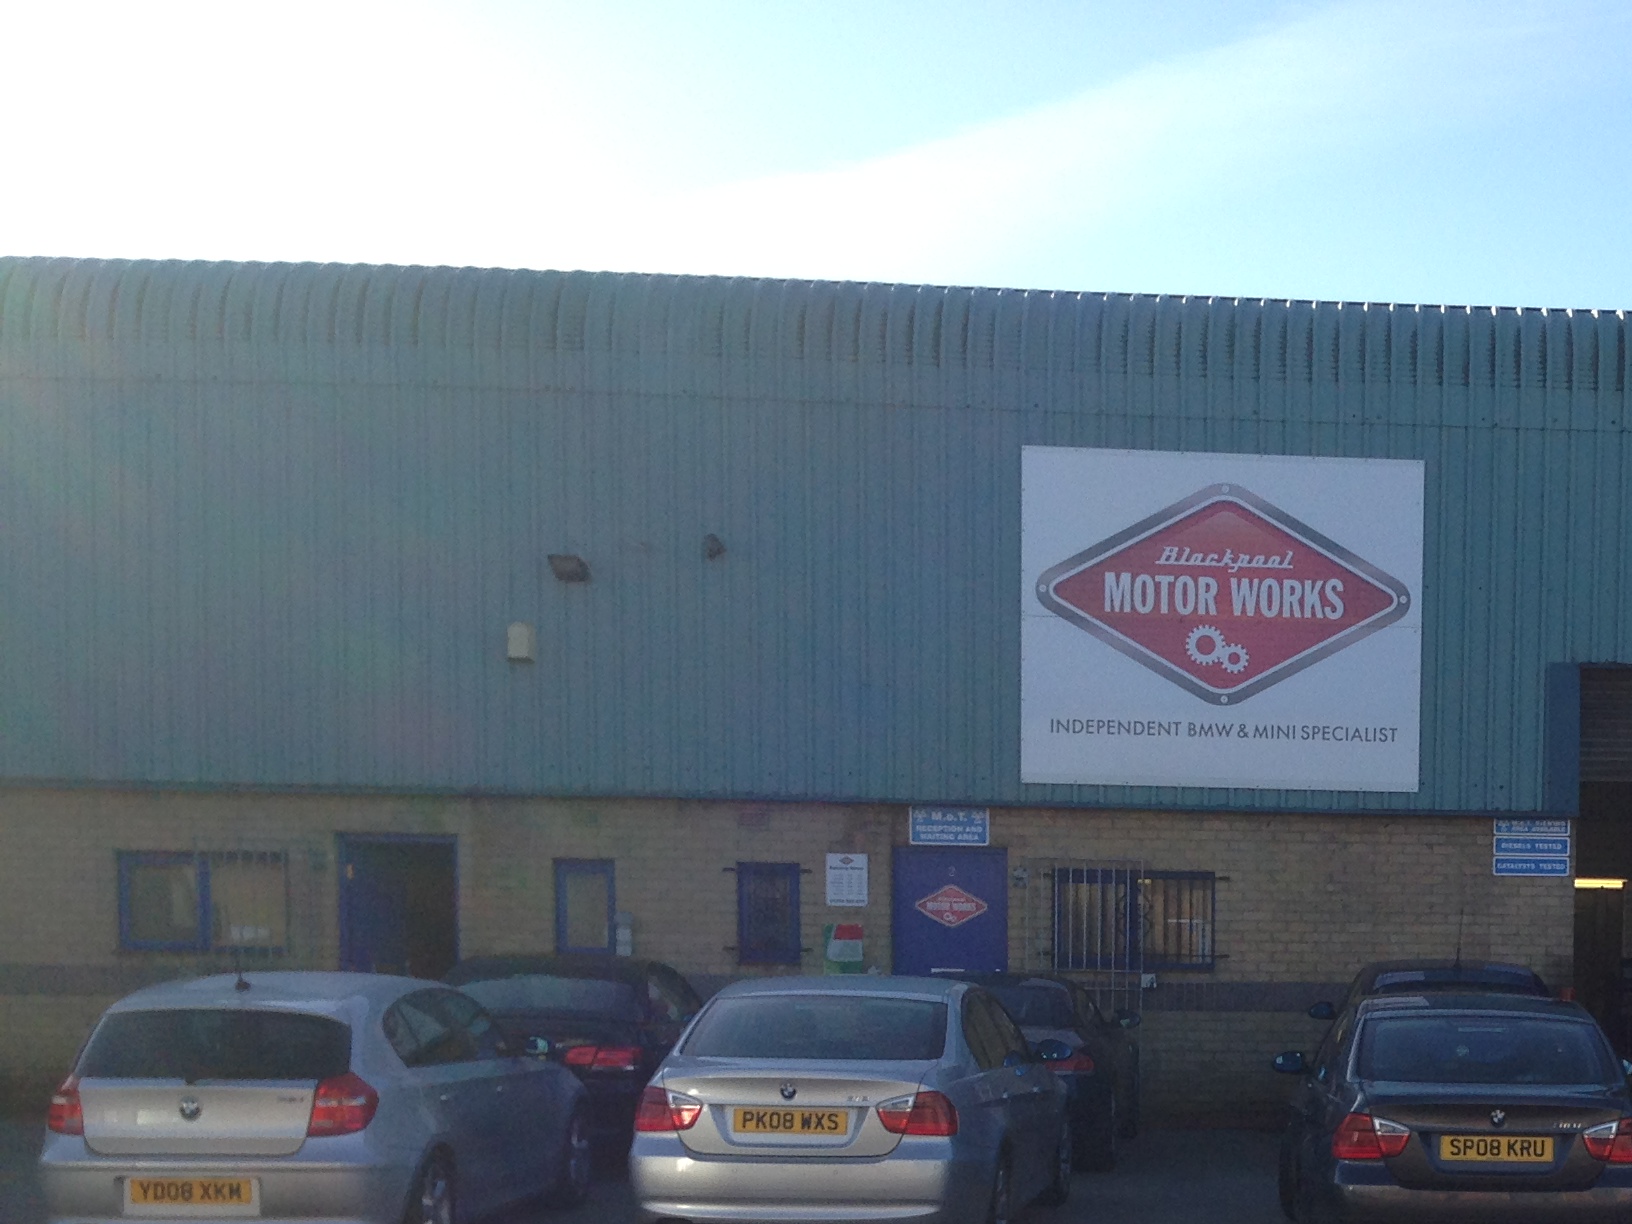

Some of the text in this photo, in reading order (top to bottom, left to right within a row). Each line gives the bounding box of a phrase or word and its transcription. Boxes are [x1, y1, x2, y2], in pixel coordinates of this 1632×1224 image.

[1155, 546, 1294, 573] Blackpool
[1103, 571, 1345, 620] MOTOR WORKS
[1049, 718, 1399, 743] INDEPENDENT BMW & MINI SPECIALIST
[915, 825, 983, 833] RECEPTION AND
[919, 833, 956, 841] WAITING
[742, 1111, 795, 1130] PK08
[1449, 1138, 1546, 1158] SP08 KRU
[139, 1181, 193, 1201] YD08
